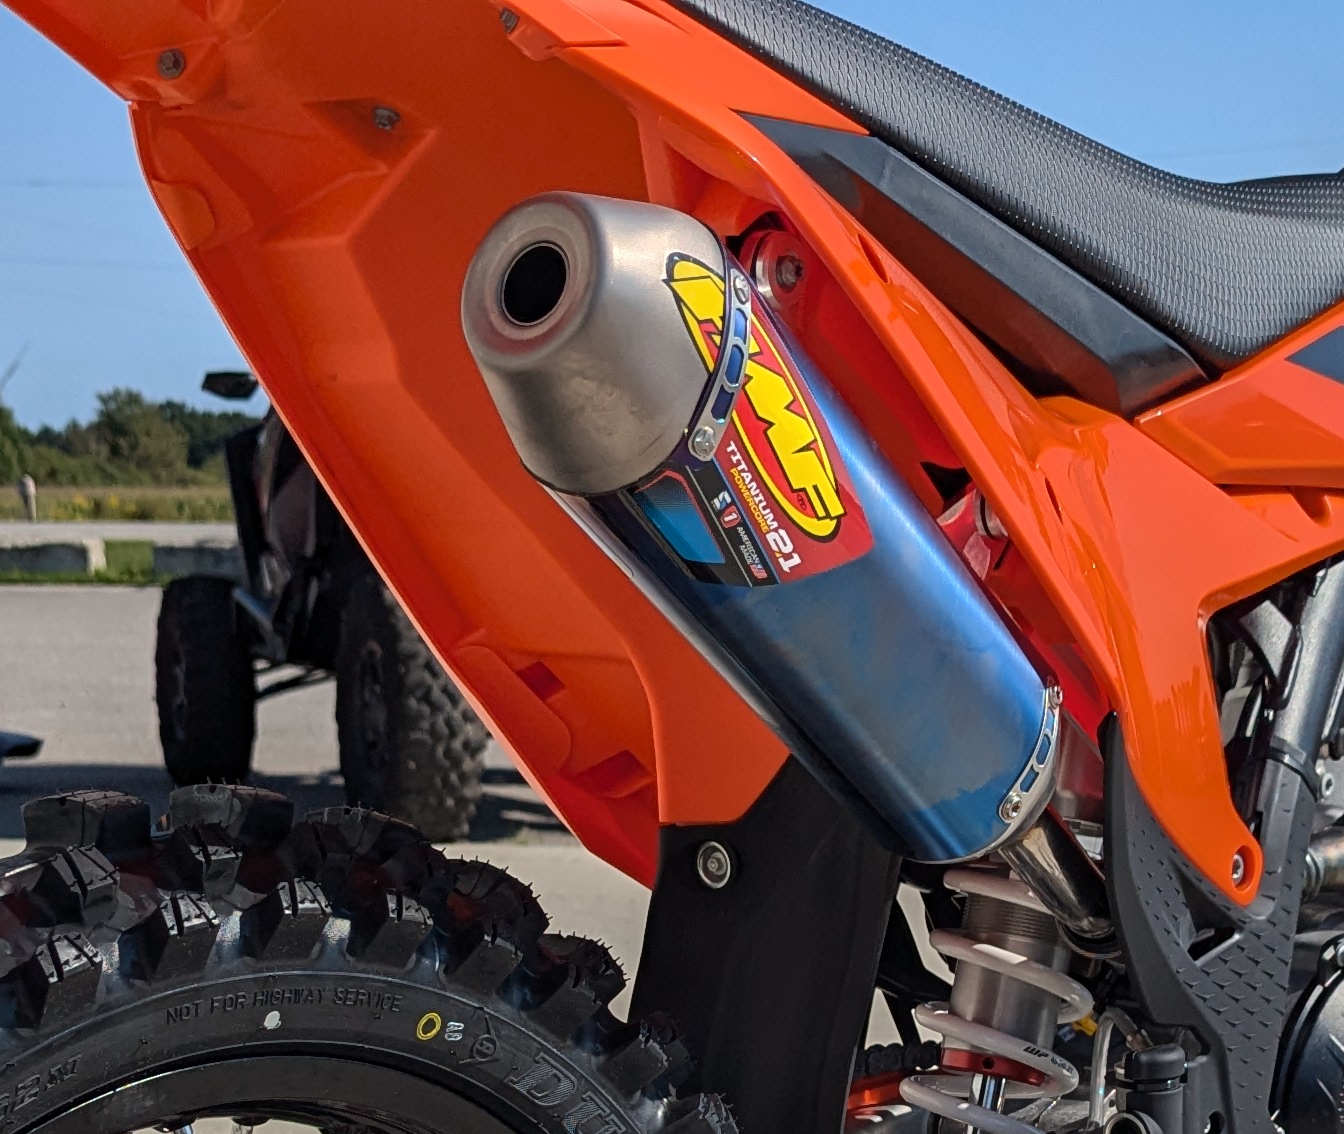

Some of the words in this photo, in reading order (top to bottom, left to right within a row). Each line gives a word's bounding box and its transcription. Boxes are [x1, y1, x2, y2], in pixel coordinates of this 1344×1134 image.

[726, 440, 778, 530] TITANIUM
[730, 467, 770, 534] POWERCORE
[166, 1003, 202, 1023] NOT
[209, 990, 246, 1014] FOR
[253, 986, 327, 1008] HIGHWAY
[333, 986, 403, 1012] SERVICE
